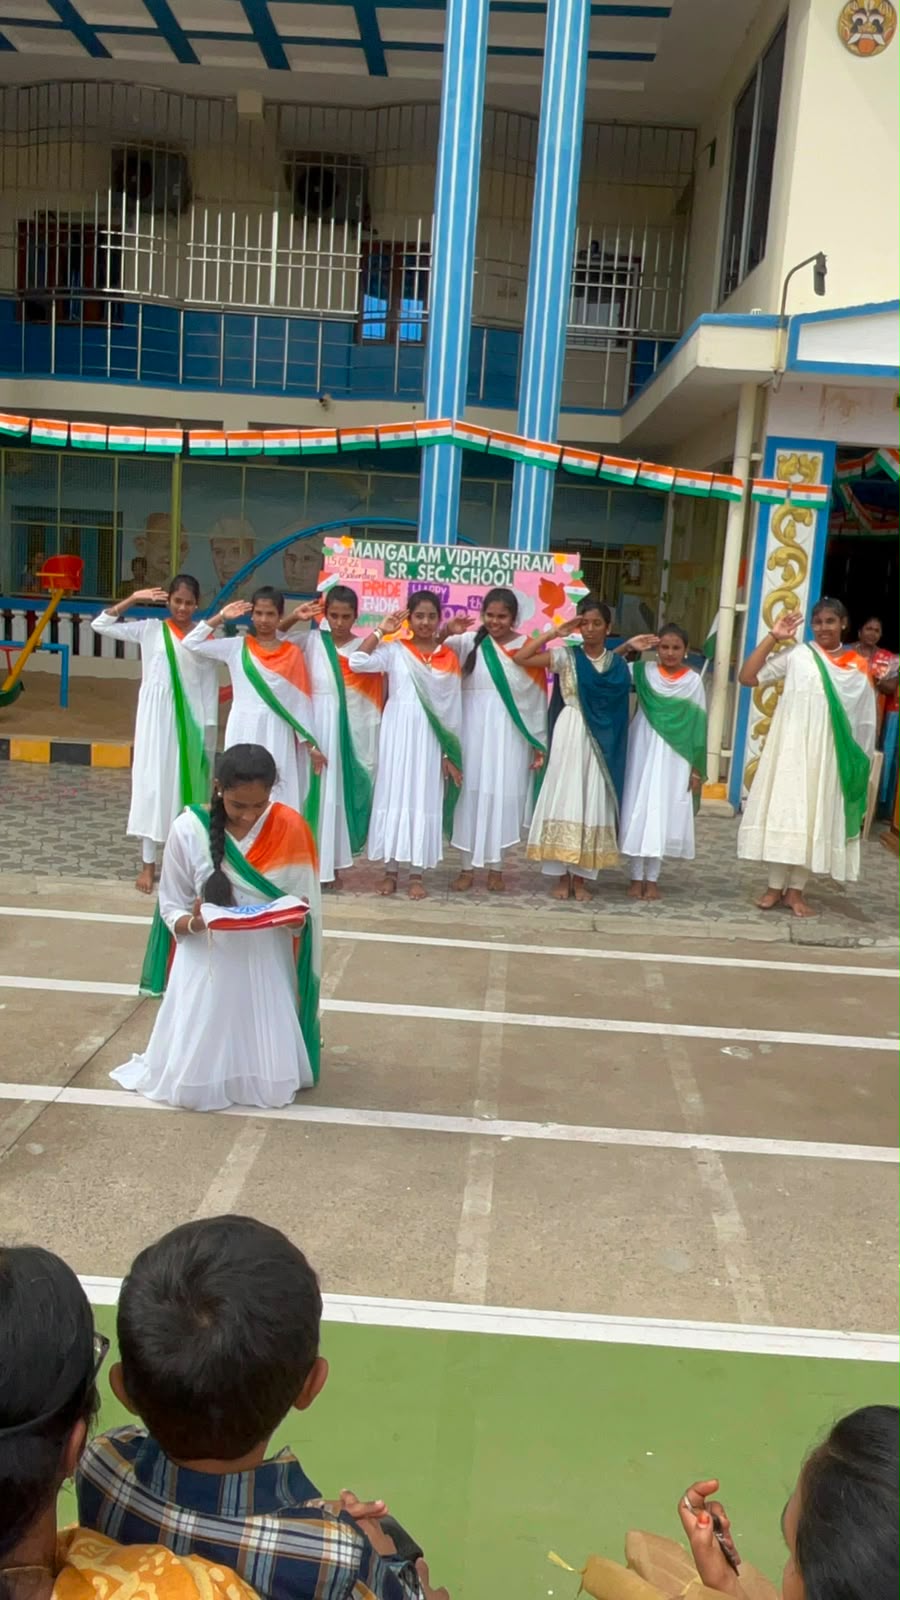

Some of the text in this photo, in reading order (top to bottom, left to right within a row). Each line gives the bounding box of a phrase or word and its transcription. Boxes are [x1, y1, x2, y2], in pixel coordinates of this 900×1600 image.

[349, 542, 555, 573] MANGALAM VIDHYASHRAM
[388, 561, 412, 579] SR.
[362, 581, 401, 597] PRIDE
[361, 597, 400, 614] INDIA
